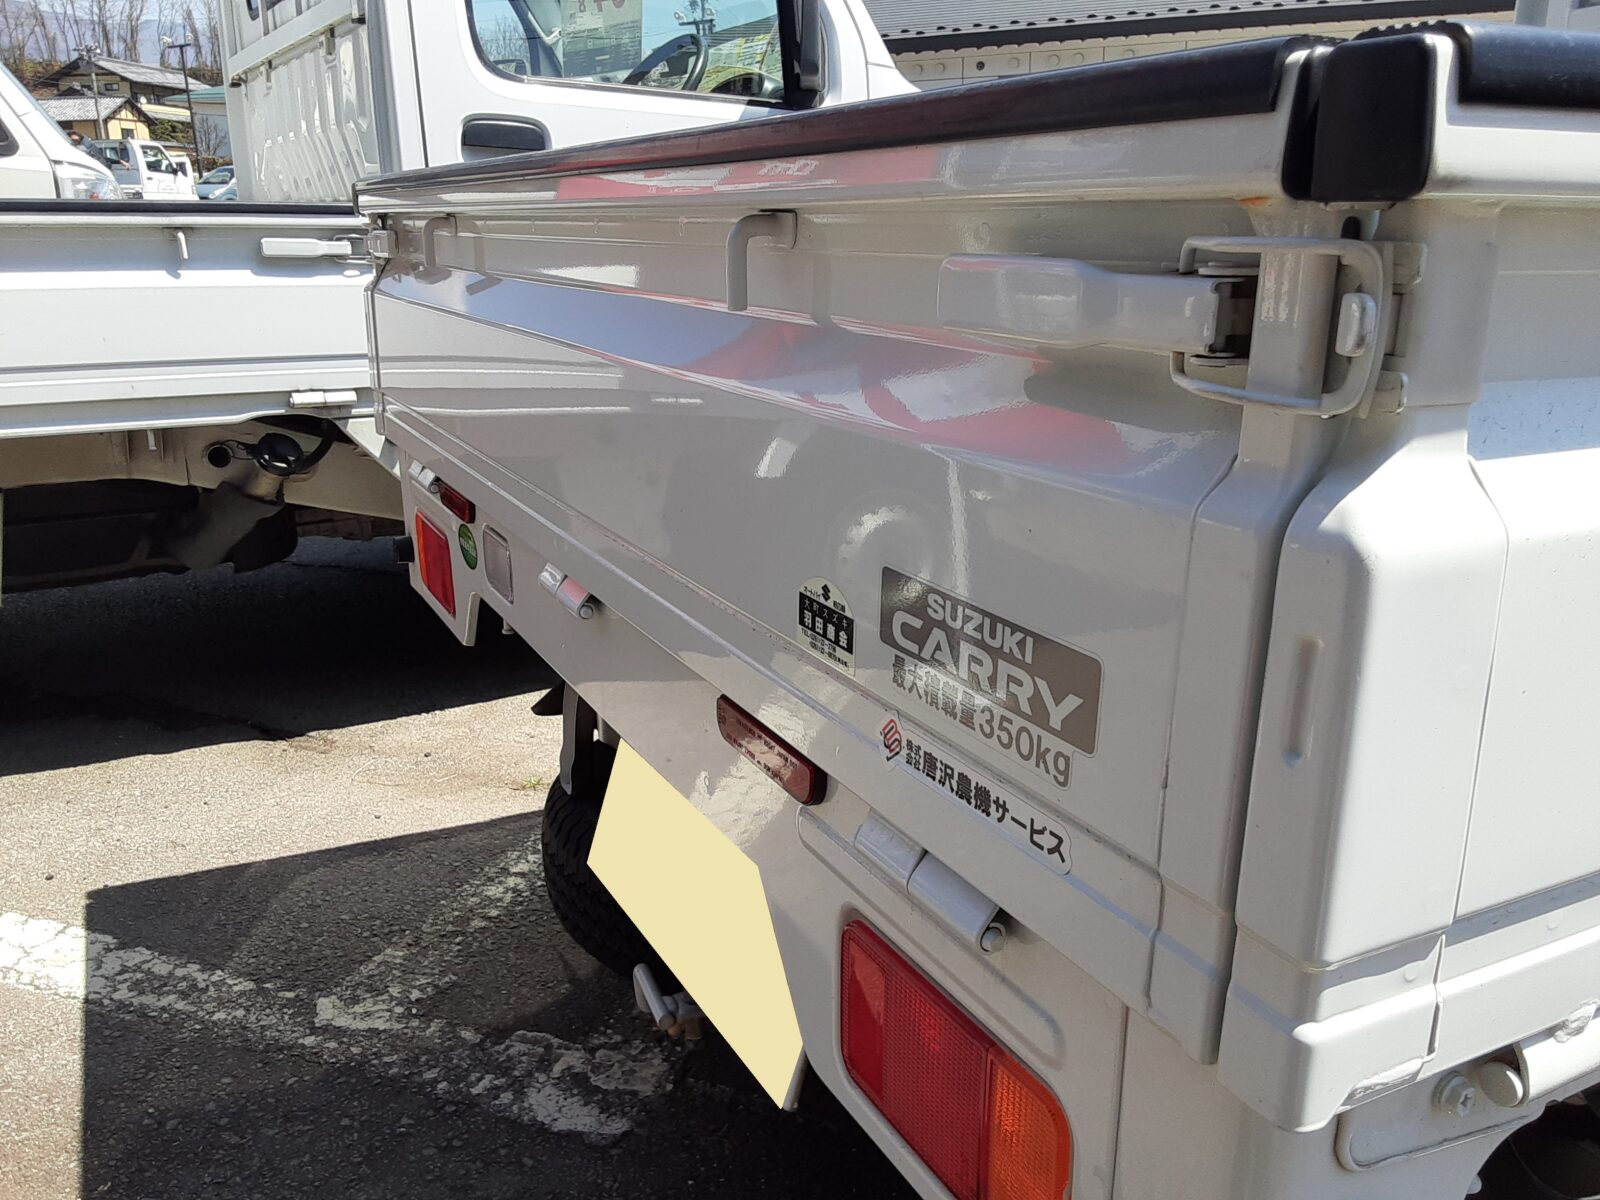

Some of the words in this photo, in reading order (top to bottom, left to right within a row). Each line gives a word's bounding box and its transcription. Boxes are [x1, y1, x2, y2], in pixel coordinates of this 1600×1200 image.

[892, 610, 1084, 732] CARRY
[927, 593, 1034, 665] SUZUKI
[892, 654, 1071, 788] 最大積載量350kg
[921, 750, 1066, 864] 唐沢農機サービス
